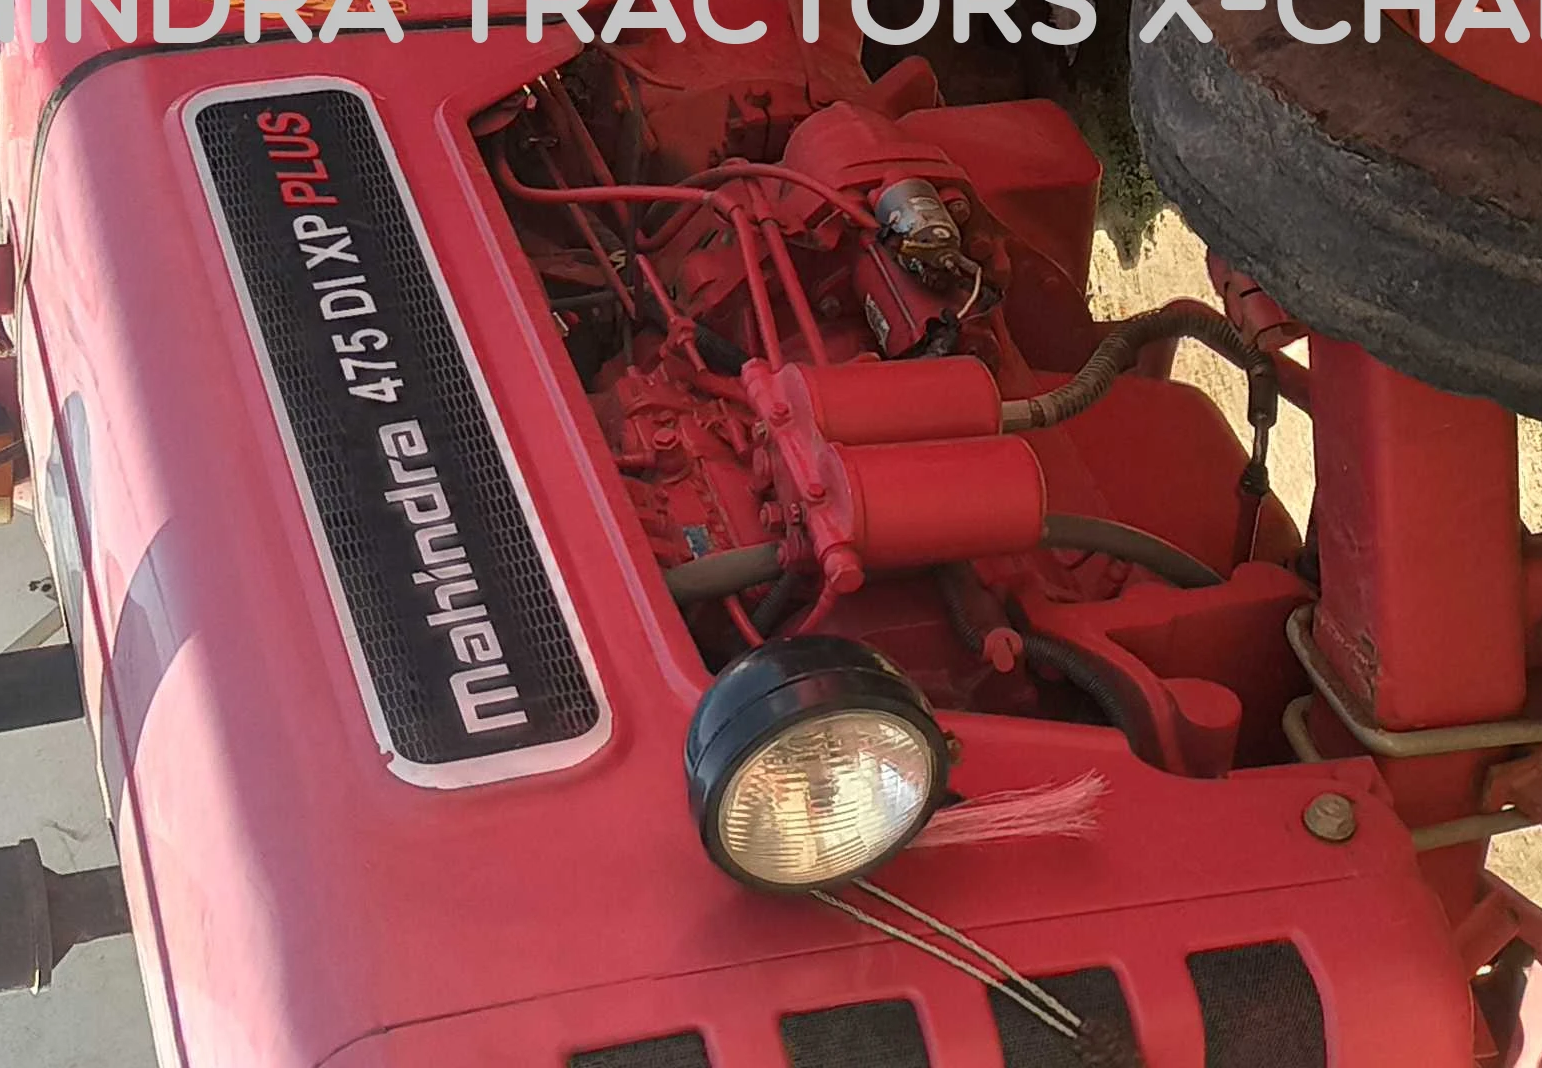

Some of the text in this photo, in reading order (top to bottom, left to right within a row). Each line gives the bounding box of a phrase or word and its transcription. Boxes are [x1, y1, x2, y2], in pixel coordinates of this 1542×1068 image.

[257, 109, 528, 734] mahindra 475 DI XP PLUS
